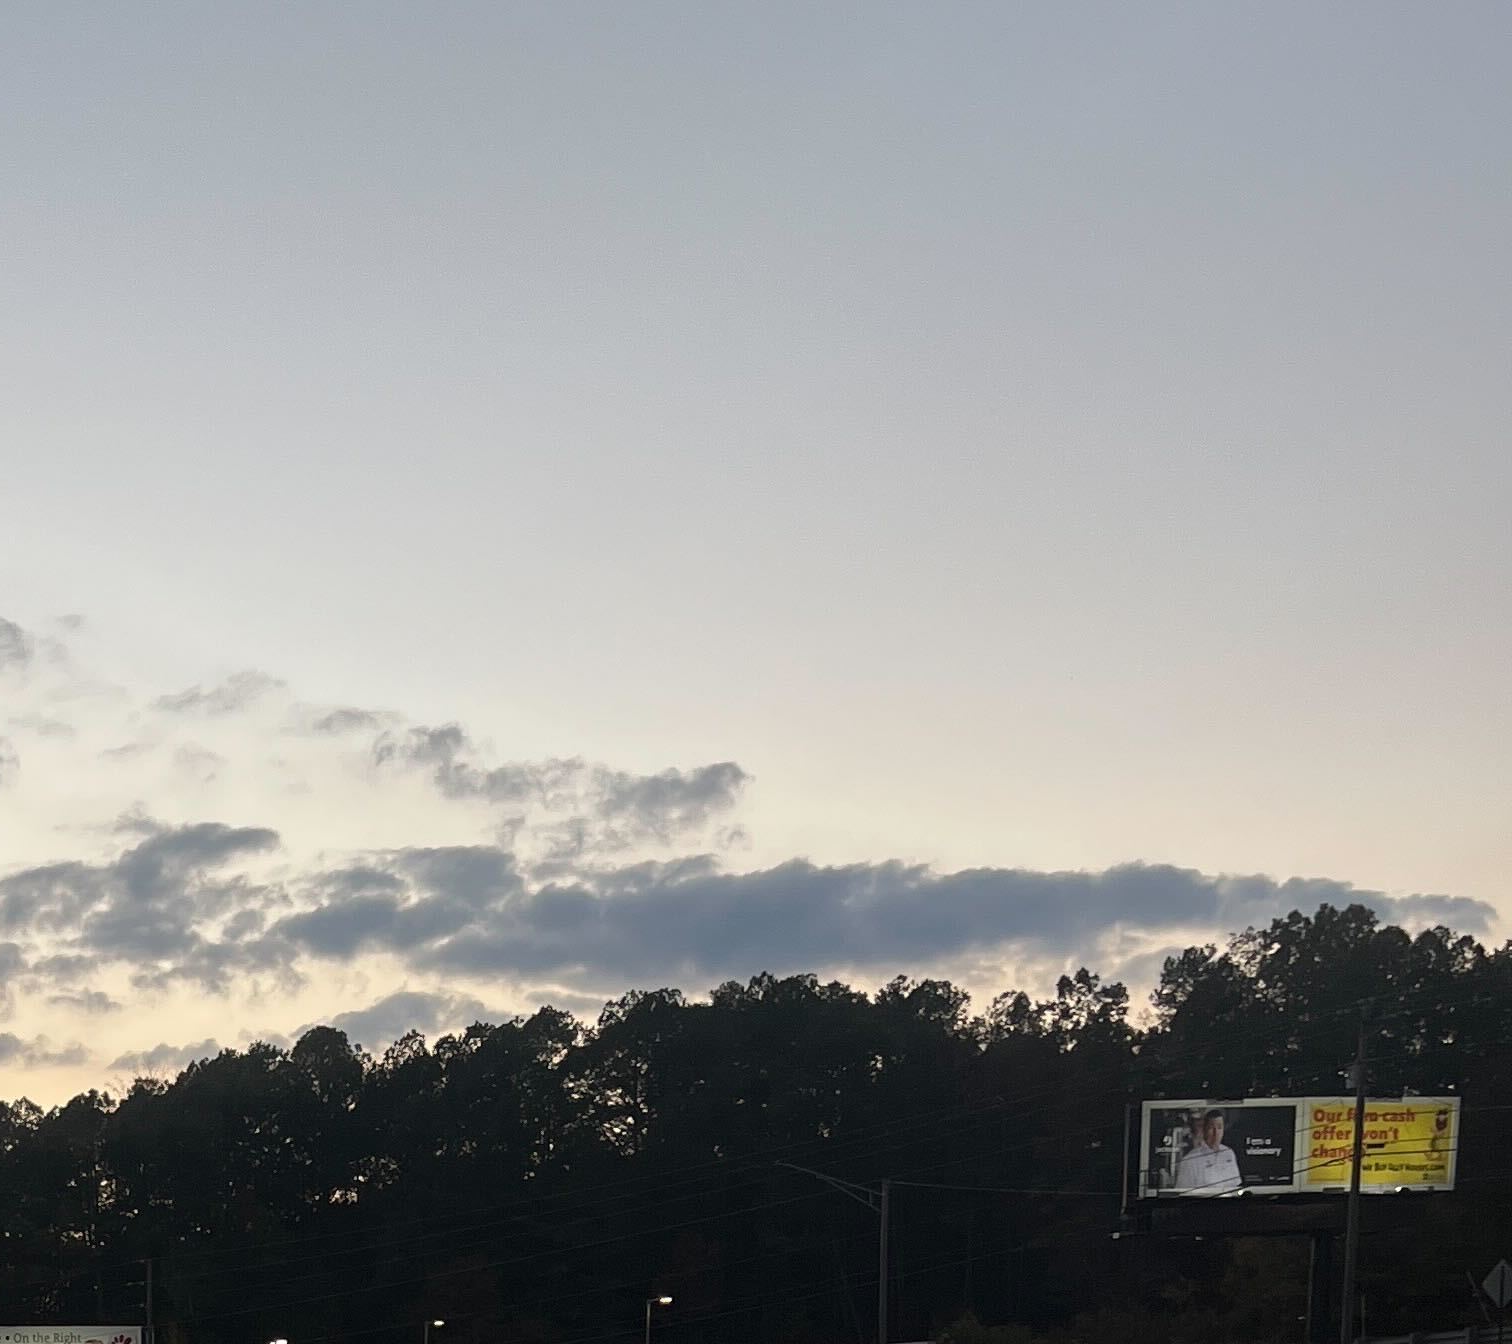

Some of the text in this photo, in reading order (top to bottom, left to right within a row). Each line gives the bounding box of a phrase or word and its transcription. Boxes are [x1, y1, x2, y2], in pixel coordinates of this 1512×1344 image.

[1313, 1108, 1416, 1122] Our fm cash
[1312, 1127, 1352, 1140] offer
[1312, 1144, 1355, 1161] chang
[13, 1332, 29, 1344] On
[32, 1332, 51, 1344] the
